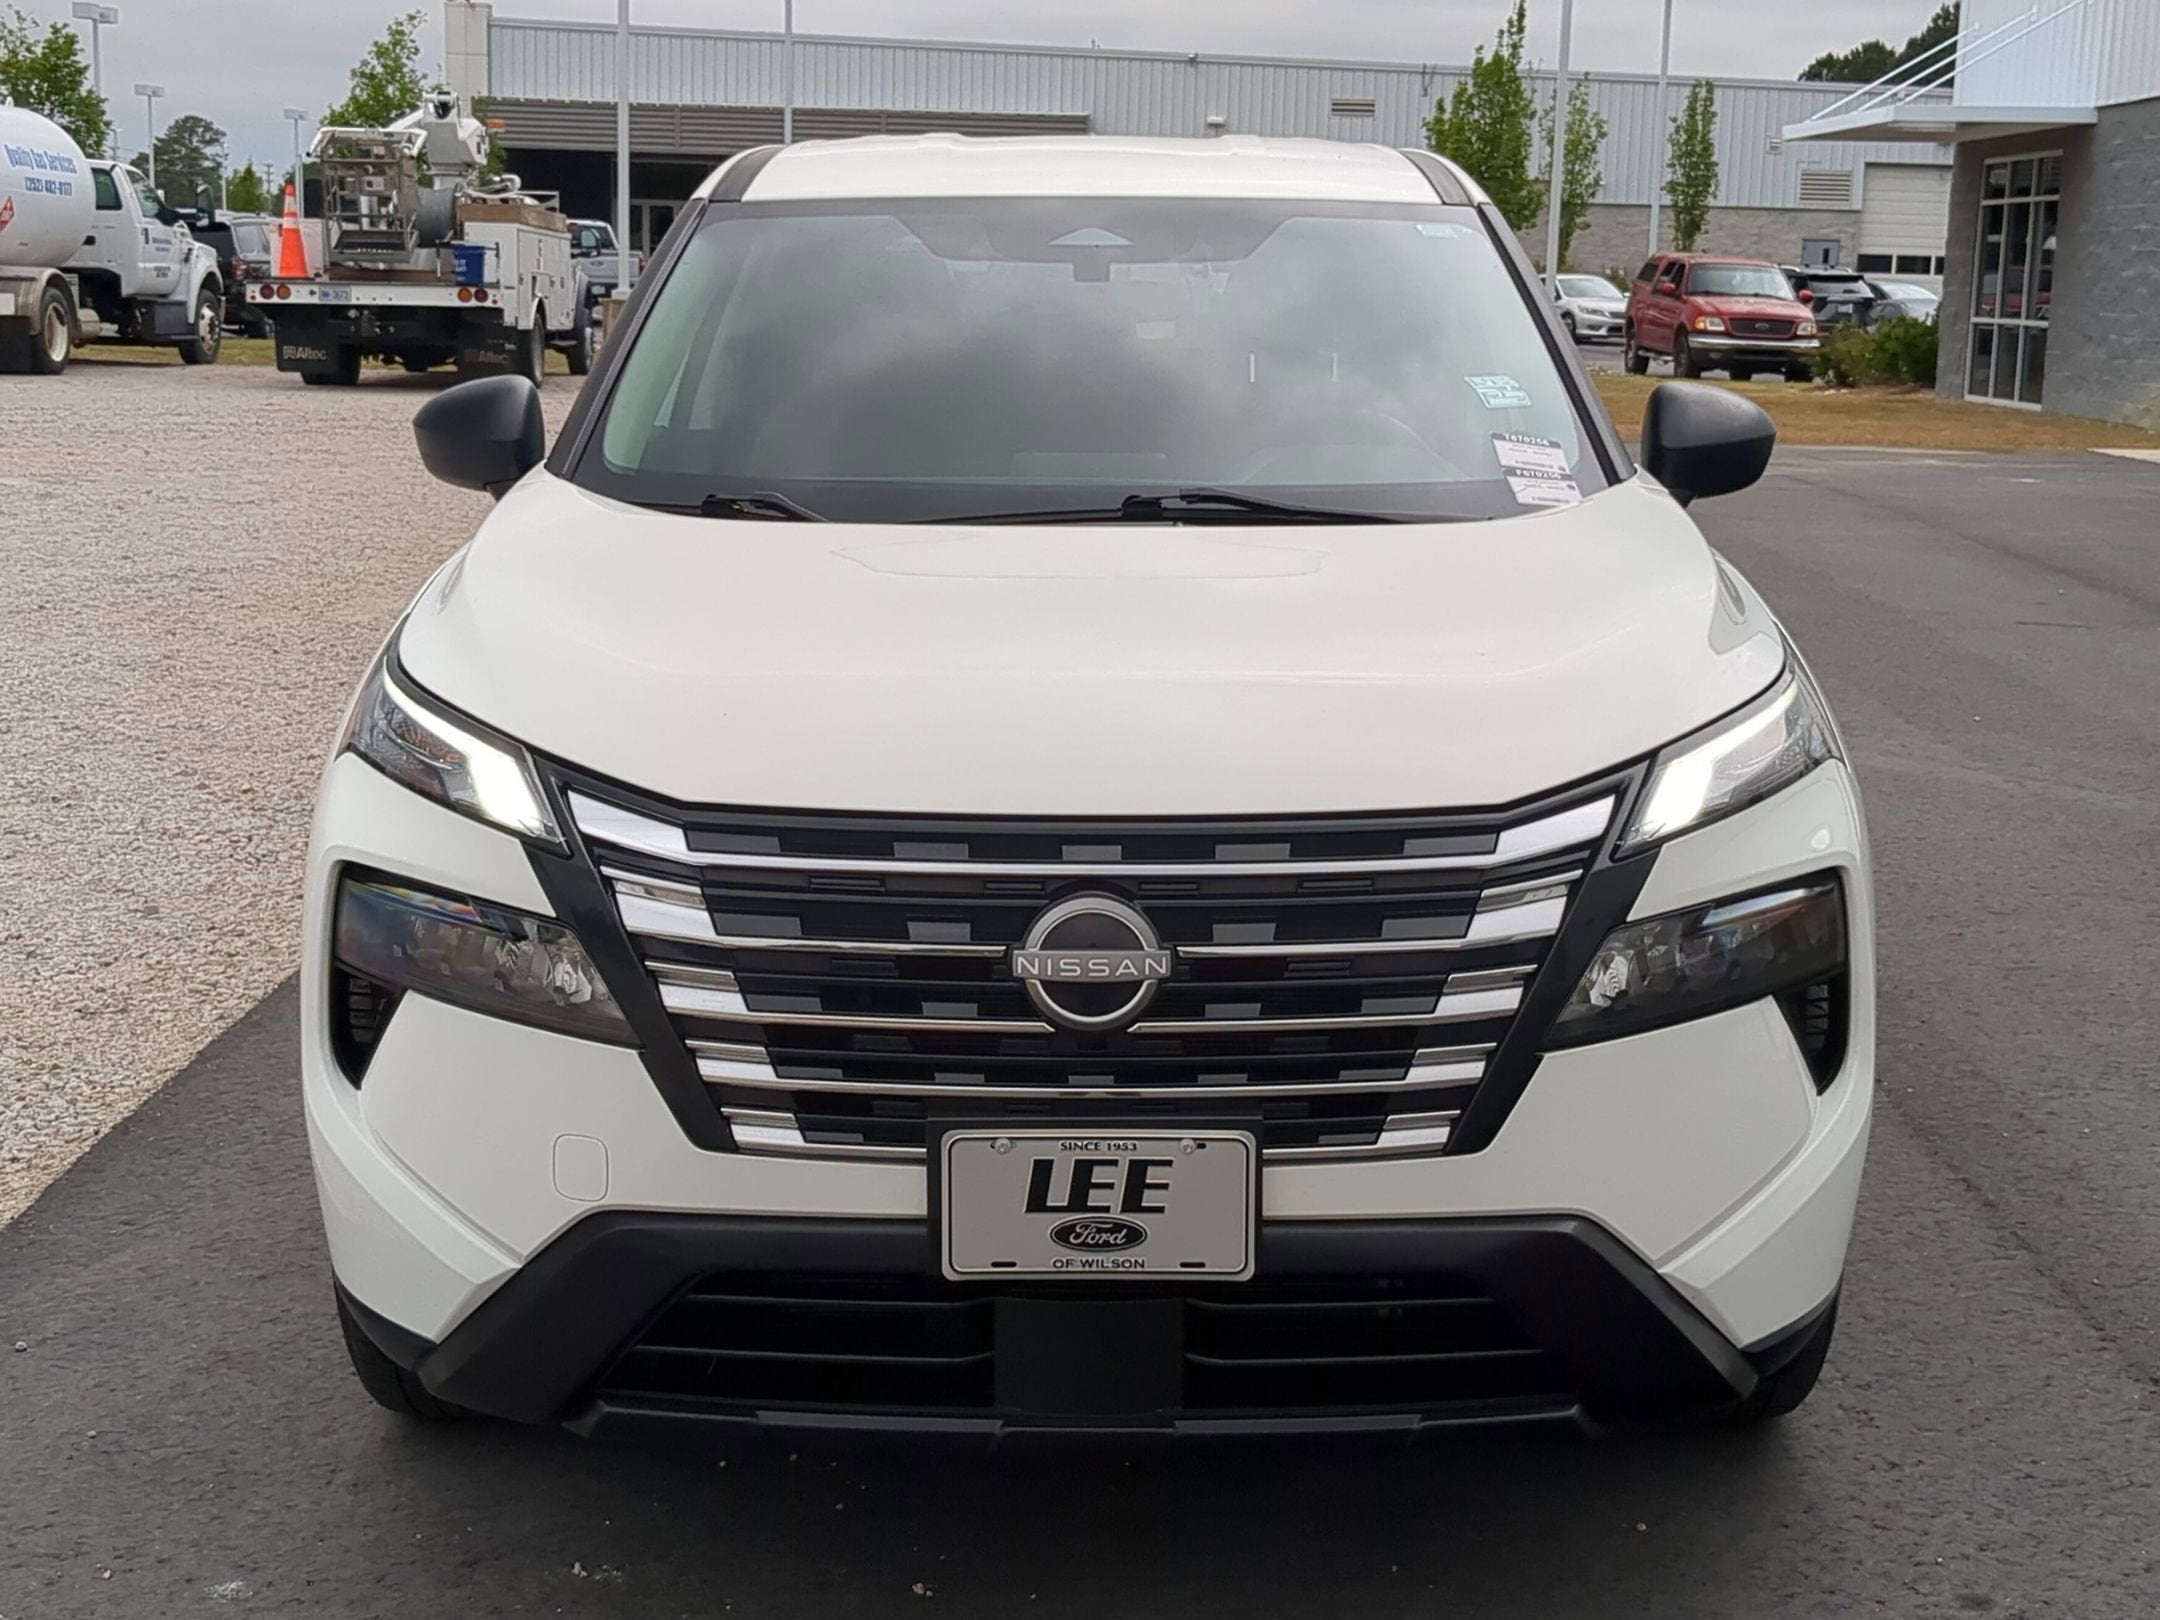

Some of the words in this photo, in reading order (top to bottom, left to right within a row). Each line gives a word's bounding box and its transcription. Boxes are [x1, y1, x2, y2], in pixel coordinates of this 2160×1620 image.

[1016, 956, 1168, 977] NISSAN
[1060, 1140, 1101, 1152] SINCE
[1106, 1140, 1138, 1152] 1953
[1024, 1157, 1174, 1214] LEE
[1068, 1222, 1128, 1246] Ford
[1052, 1257, 1076, 1270] OF
[1079, 1257, 1146, 1270] WILSON
